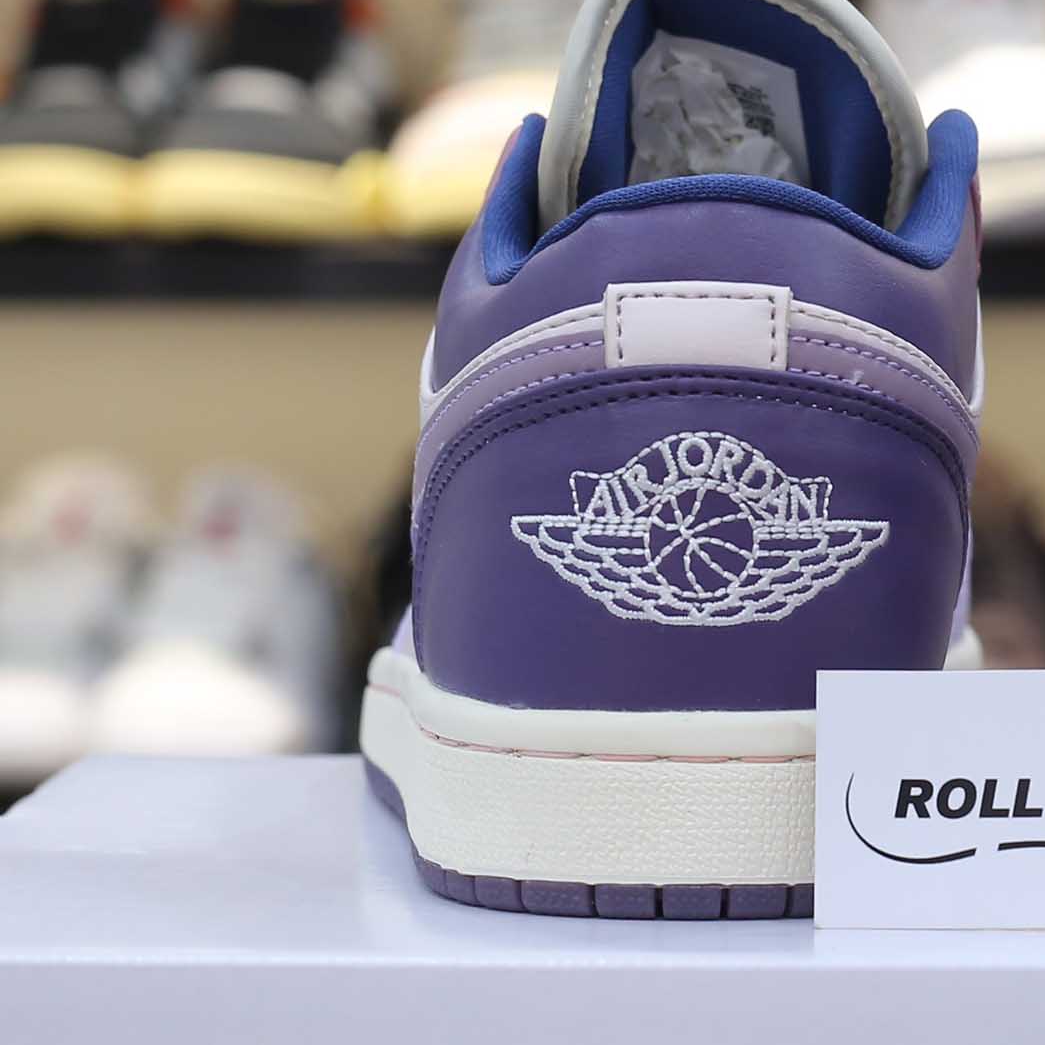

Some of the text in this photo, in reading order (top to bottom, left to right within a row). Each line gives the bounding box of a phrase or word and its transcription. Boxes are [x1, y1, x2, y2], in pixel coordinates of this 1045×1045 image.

[582, 436, 820, 523] AIR JORDAN
[894, 778, 1043, 819] ROLL
